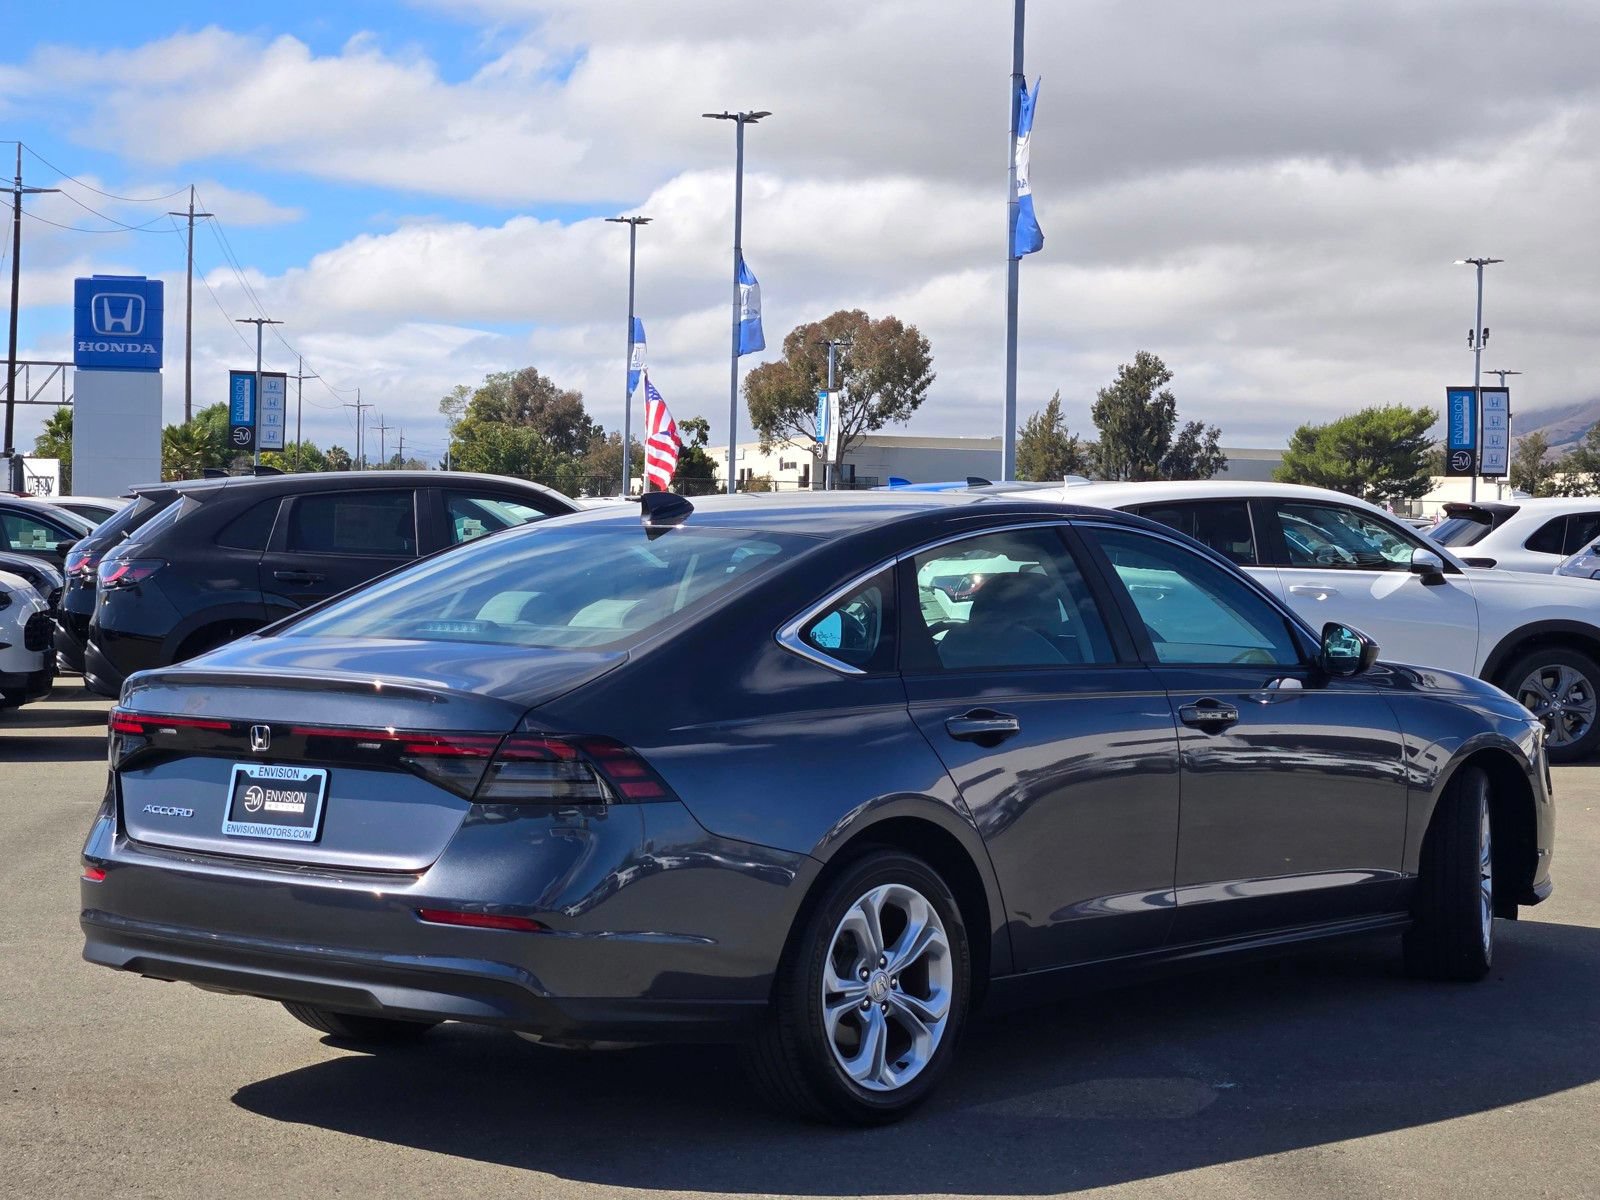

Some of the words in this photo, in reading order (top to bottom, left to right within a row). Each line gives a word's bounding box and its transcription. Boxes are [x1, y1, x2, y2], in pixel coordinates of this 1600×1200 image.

[78, 341, 157, 353] HONDA
[236, 378, 244, 422] ENVISION
[1454, 395, 1463, 445] ENVISION
[258, 766, 300, 779] ENVISION
[265, 789, 307, 803] ENVISION
[142, 804, 194, 817] ACCORD
[226, 824, 312, 839] ENVISIONMOTORS.COM
